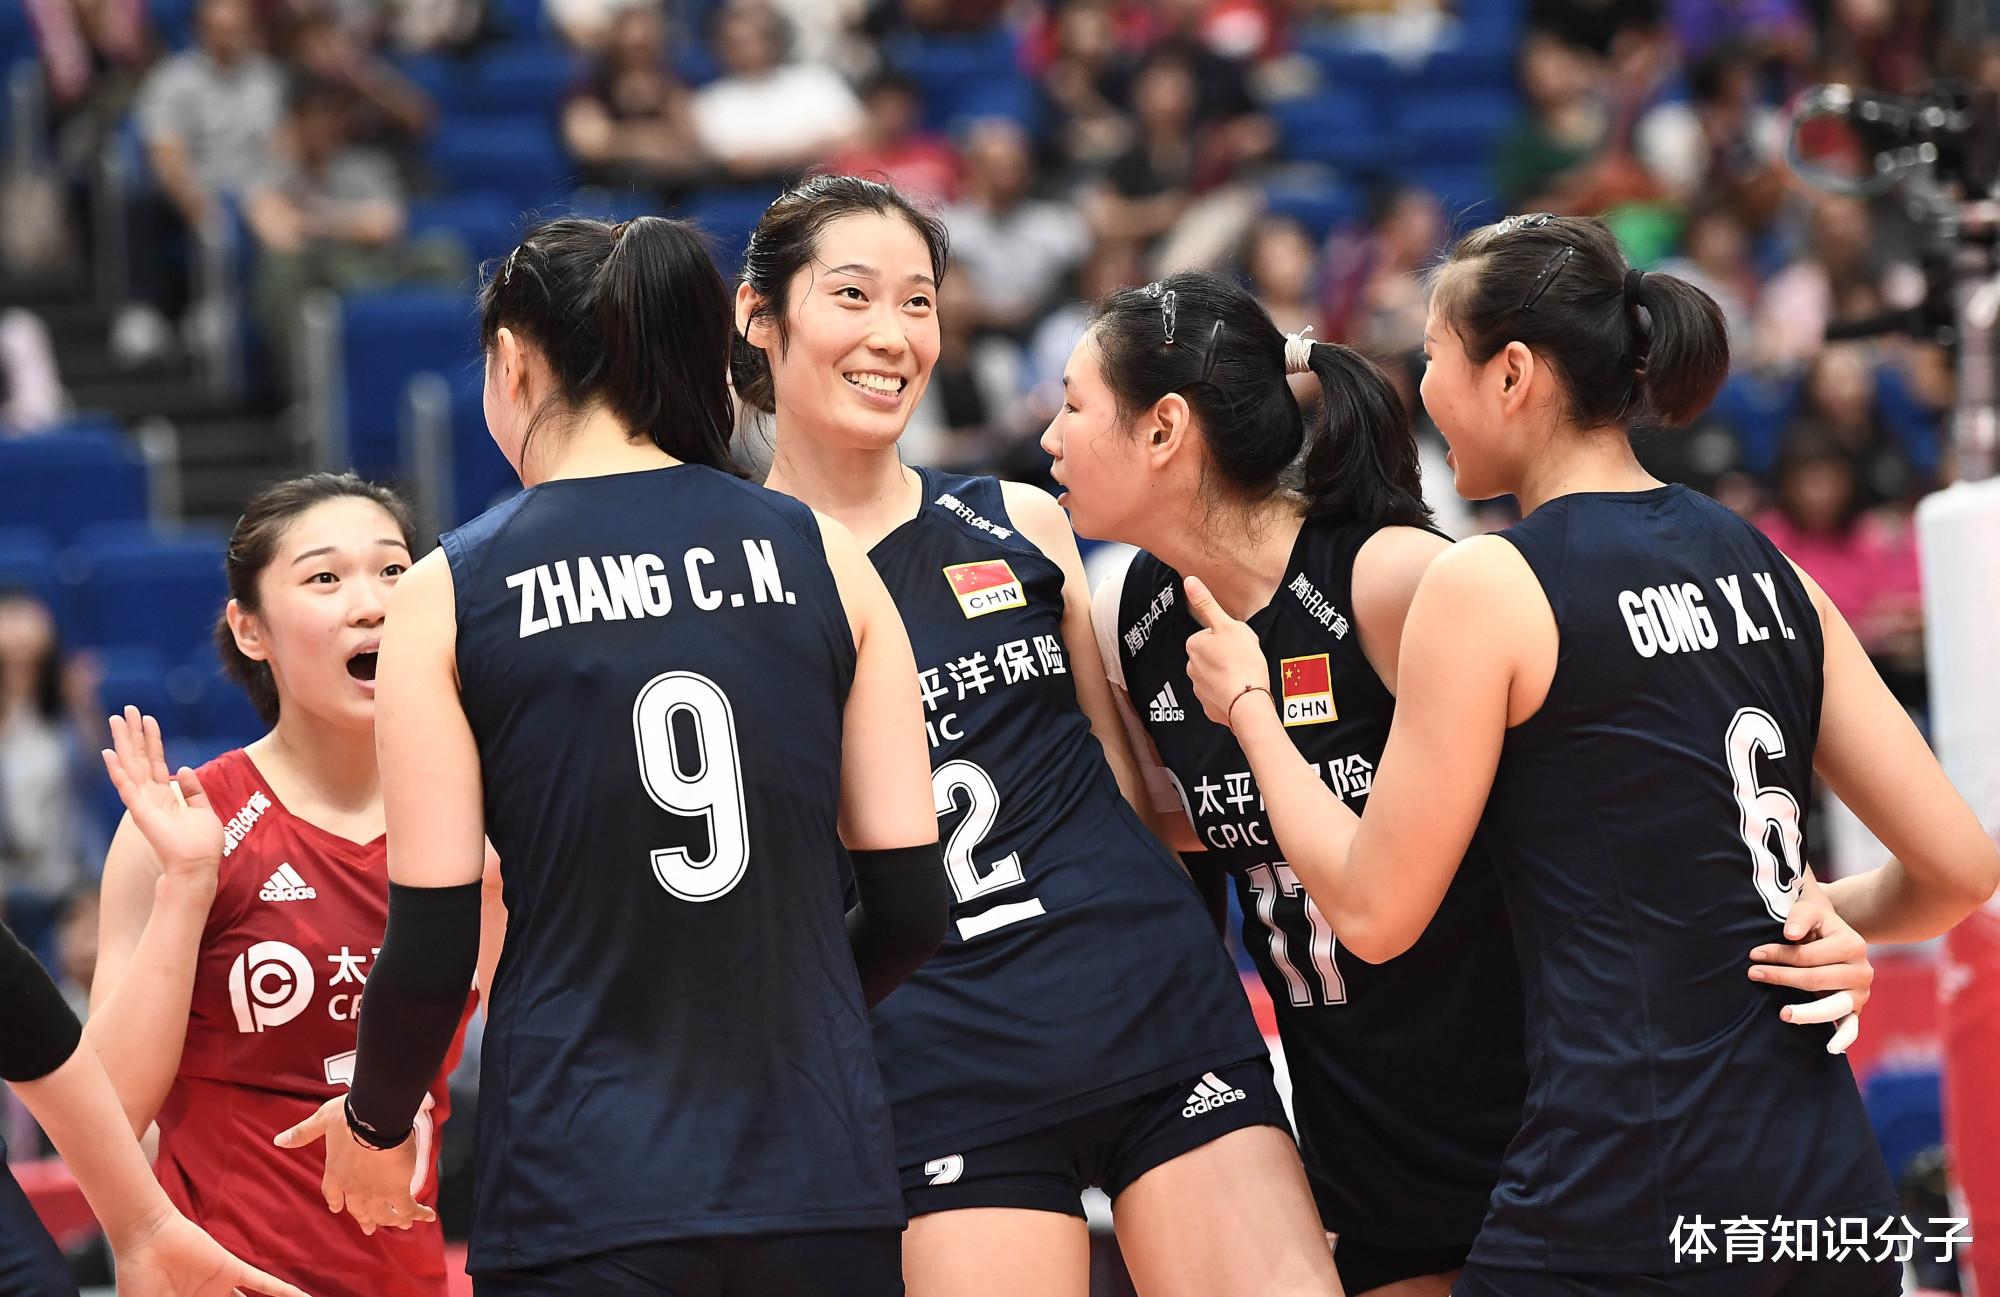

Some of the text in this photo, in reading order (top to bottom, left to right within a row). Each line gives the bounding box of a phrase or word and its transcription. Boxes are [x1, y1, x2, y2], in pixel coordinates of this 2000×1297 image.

[934, 493, 1014, 541] 腾讯体育
[505, 553, 672, 639] ZHANG
[969, 587, 1019, 609] CHN
[1123, 581, 1176, 658] 腾讯体育
[1288, 571, 1351, 641] 腾讯体育
[1617, 582, 1719, 659] GONG
[1287, 700, 1328, 719] CHN
[632, 669, 751, 903] 9
[1724, 706, 1802, 923] 6
[931, 759, 1027, 905] 2
[1207, 821, 1269, 850] CPIC
[259, 885, 317, 902] adidas
[1244, 861, 1348, 1008] 17
[1181, 1086, 1246, 1119] adidas
